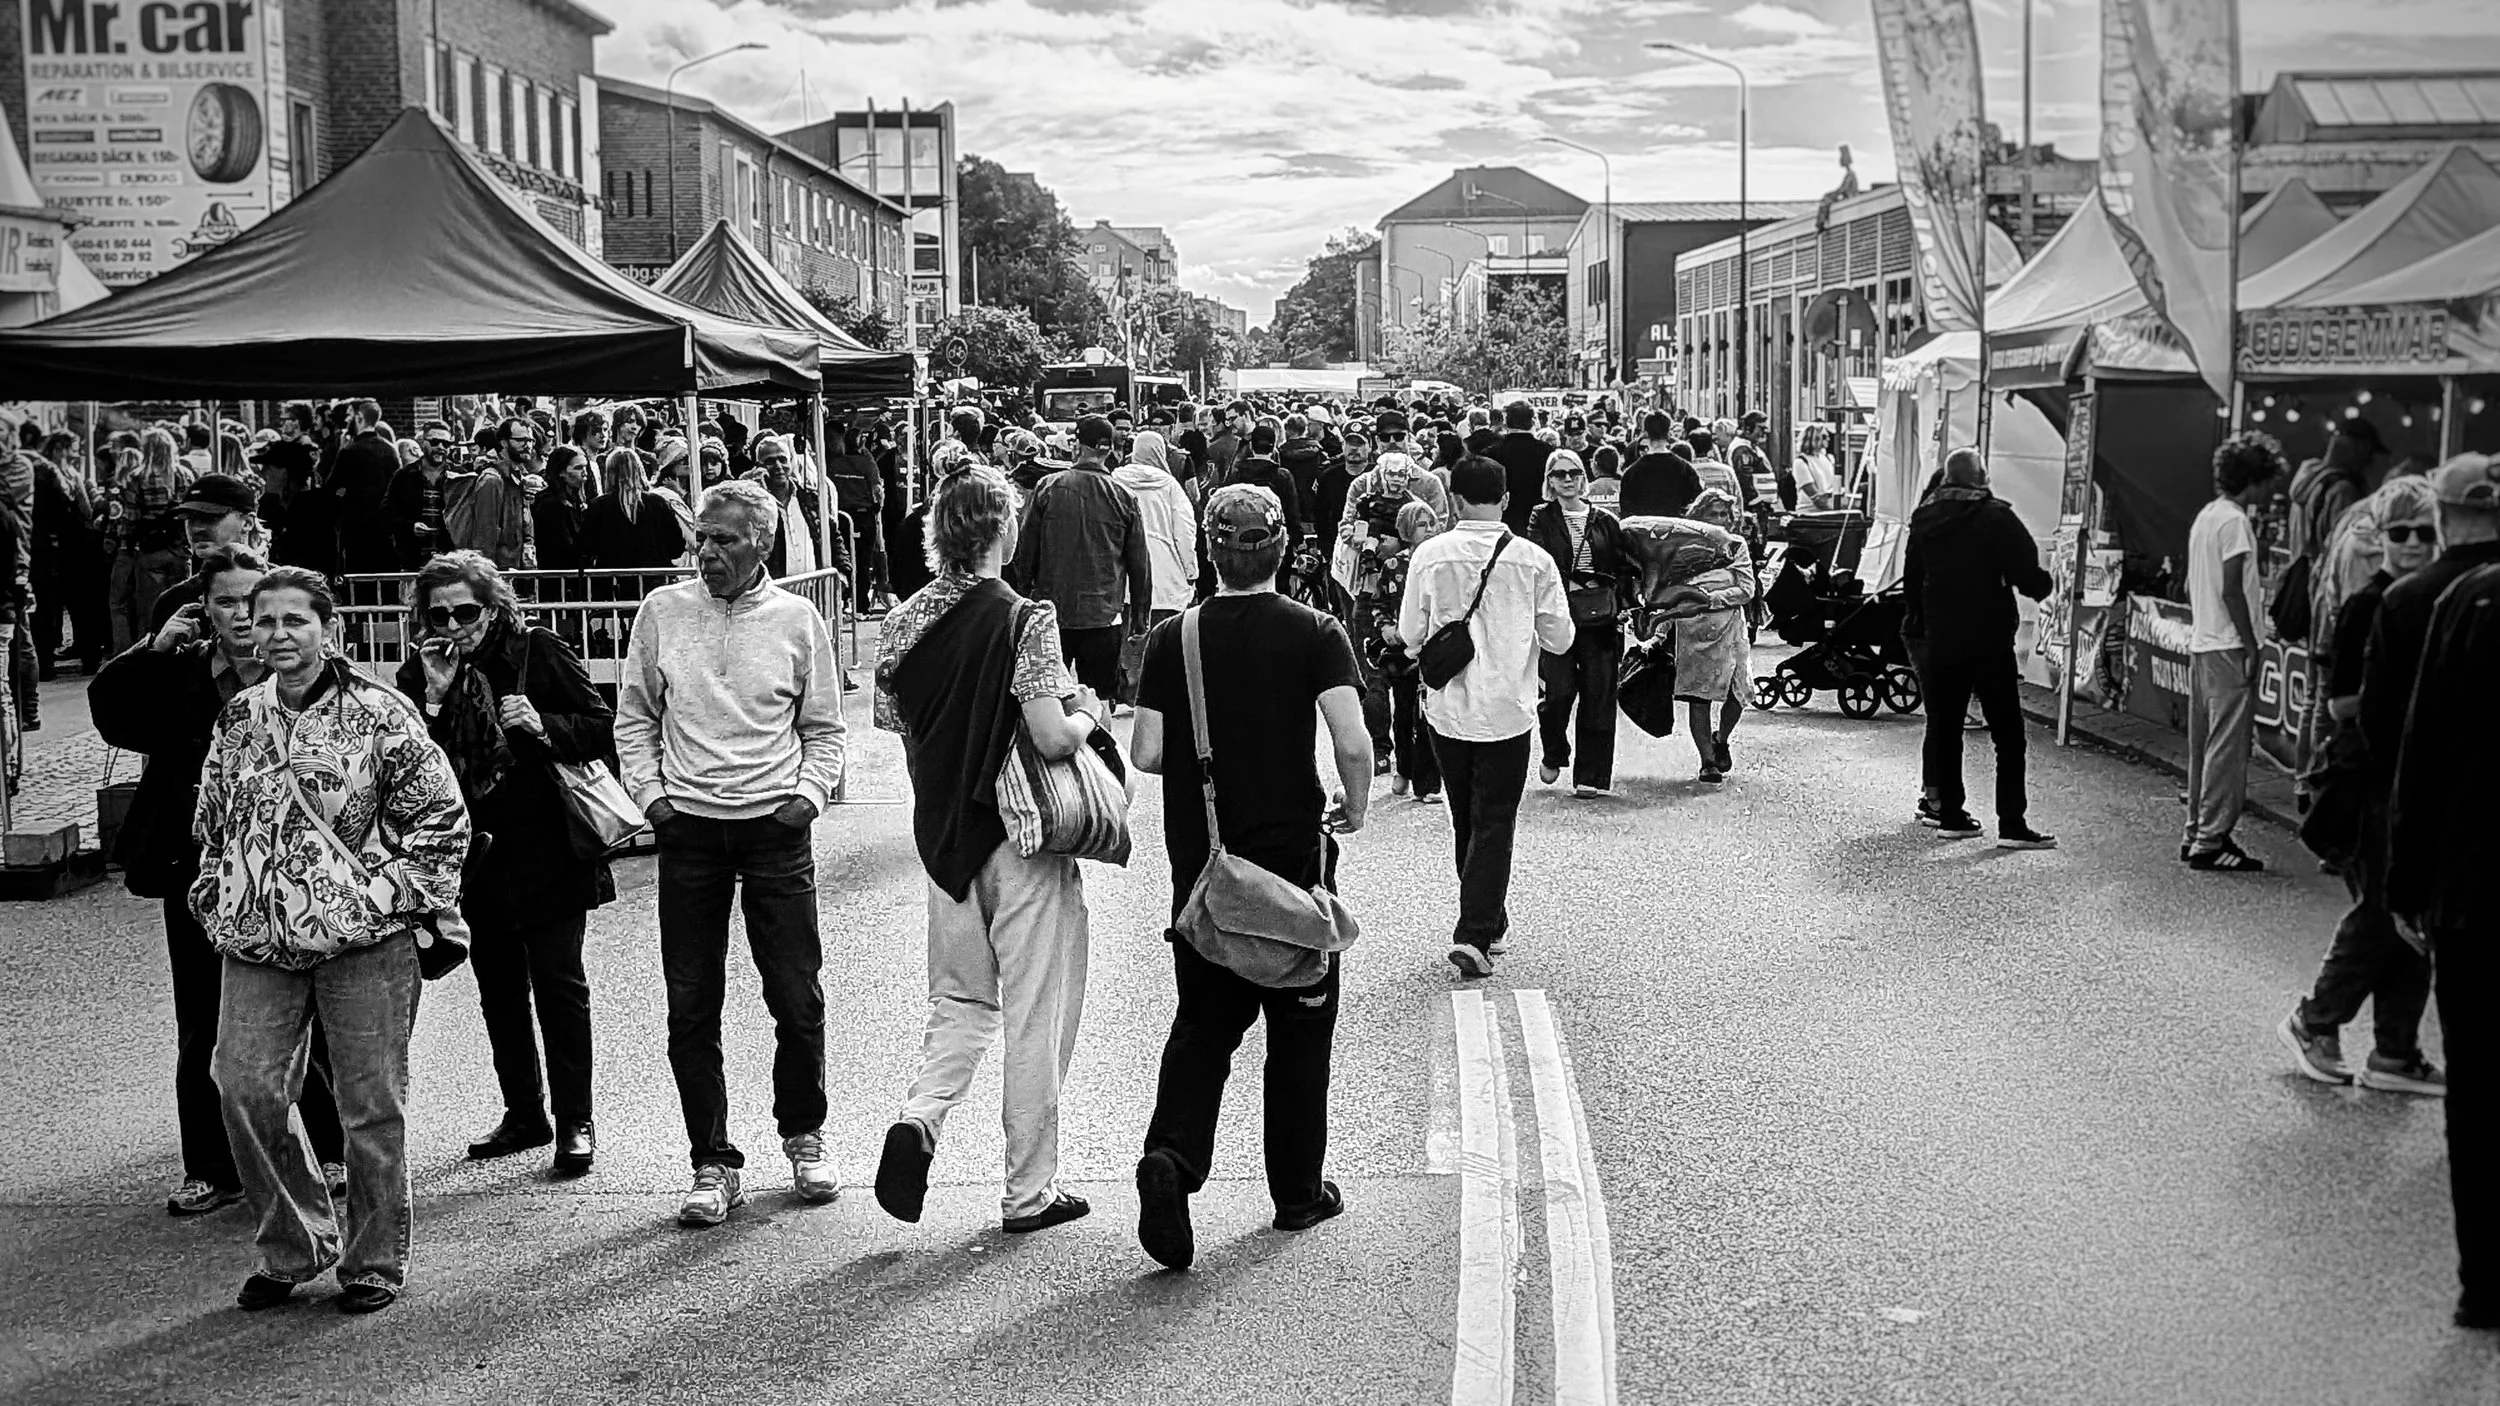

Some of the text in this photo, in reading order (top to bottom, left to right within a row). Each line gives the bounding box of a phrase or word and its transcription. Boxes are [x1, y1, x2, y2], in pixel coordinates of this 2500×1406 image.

[30, 0, 253, 54] Mr. car
[31, 61, 255, 79] REPARATION & BILSERVICE
[77, 253, 101, 263] 700
